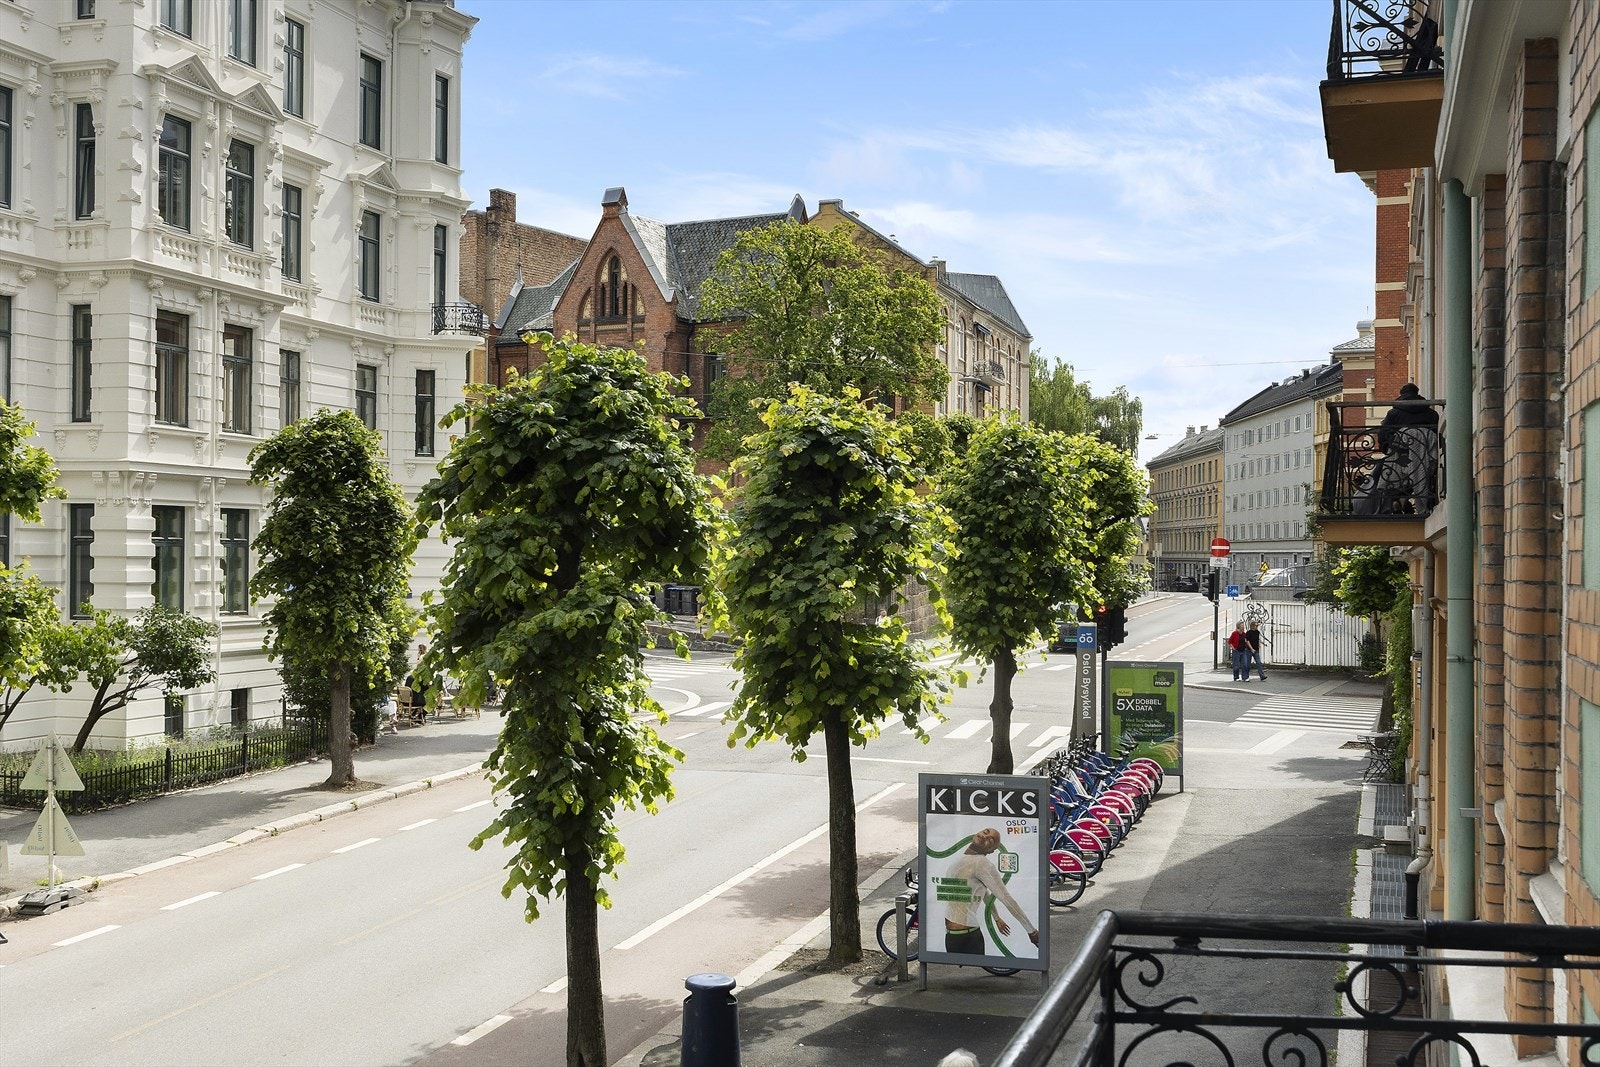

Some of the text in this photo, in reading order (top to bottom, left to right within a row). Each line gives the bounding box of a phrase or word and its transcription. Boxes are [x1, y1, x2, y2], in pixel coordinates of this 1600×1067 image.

[1080, 653, 1092, 719] Oslo Bysykkel
[1116, 698, 1135, 711] 5X
[931, 787, 1037, 816] KICKS
[1006, 819, 1027, 827] OSLO
[1007, 825, 1037, 835] PRIDE
